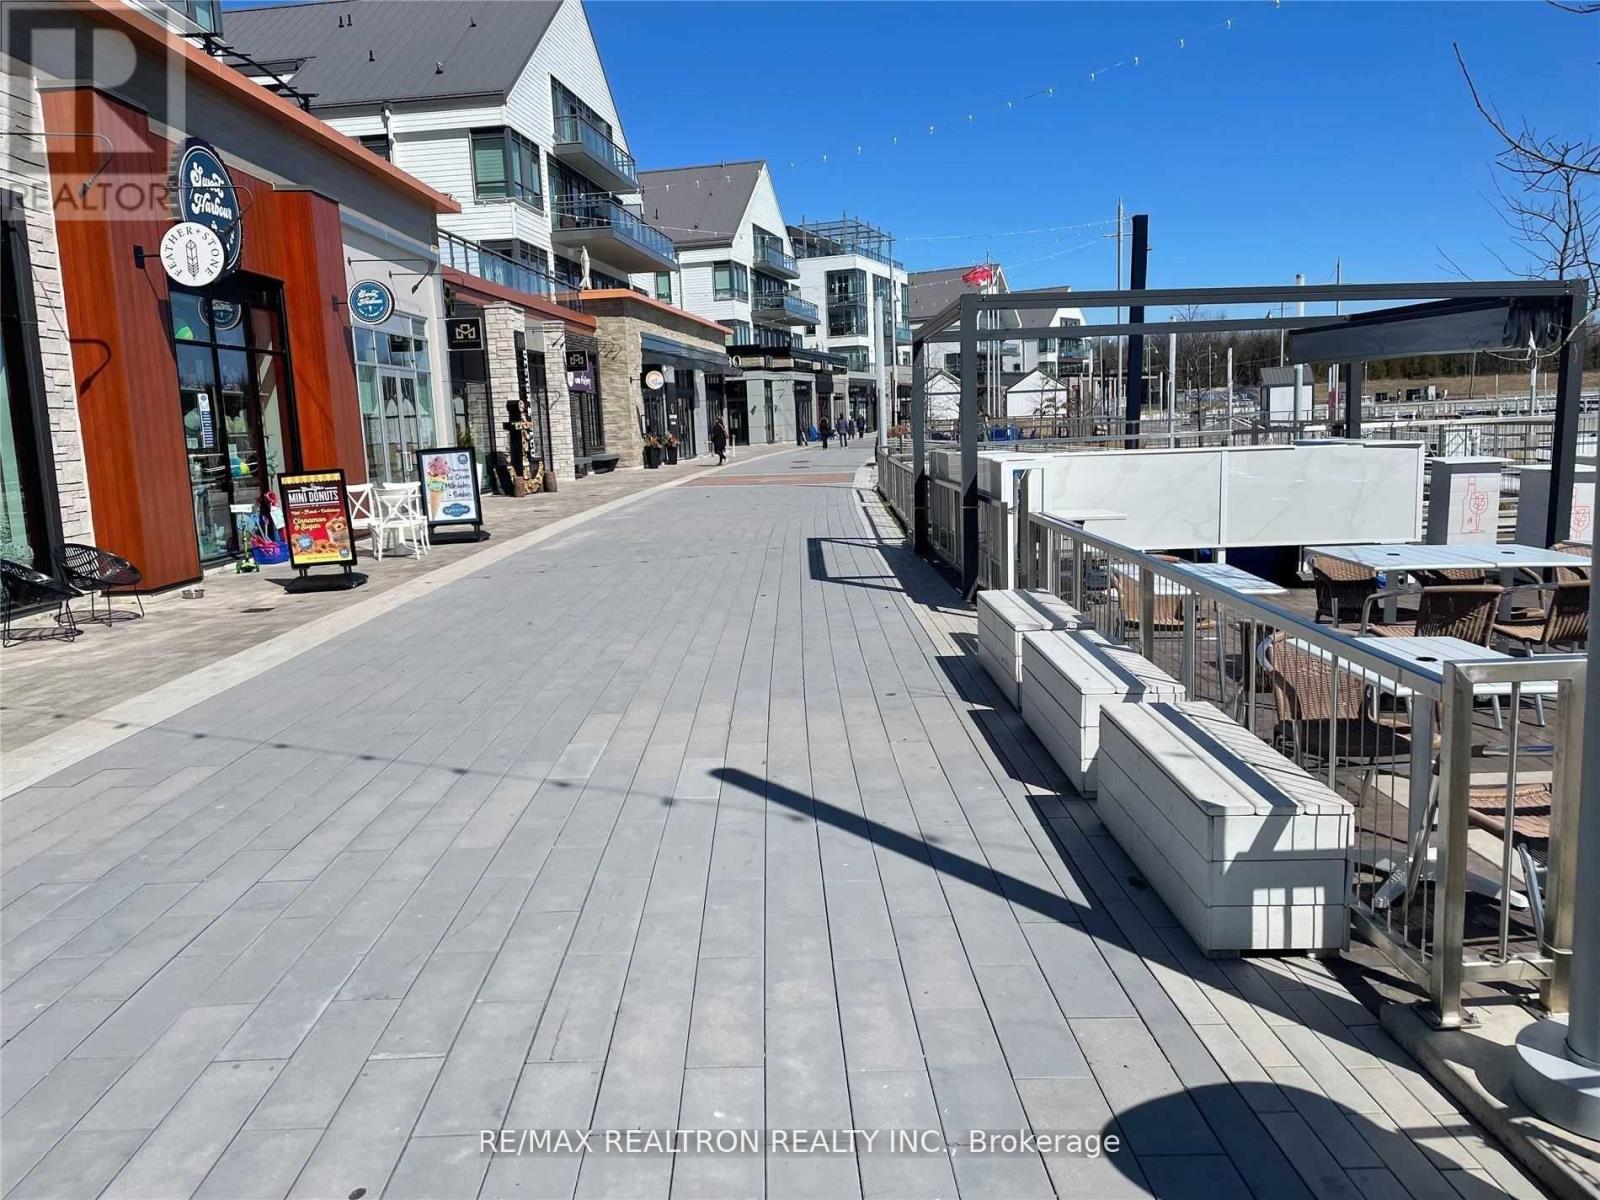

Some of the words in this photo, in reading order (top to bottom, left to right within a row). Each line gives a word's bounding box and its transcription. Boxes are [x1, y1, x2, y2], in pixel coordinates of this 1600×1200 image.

[191, 192, 232, 220] Harbour
[165, 226, 193, 277] FEATHER
[202, 231, 220, 277] STONE
[288, 492, 308, 504] MINI
[308, 490, 339, 502] DONUTS
[293, 517, 327, 525] Cinnamon
[300, 523, 321, 531] Sugar
